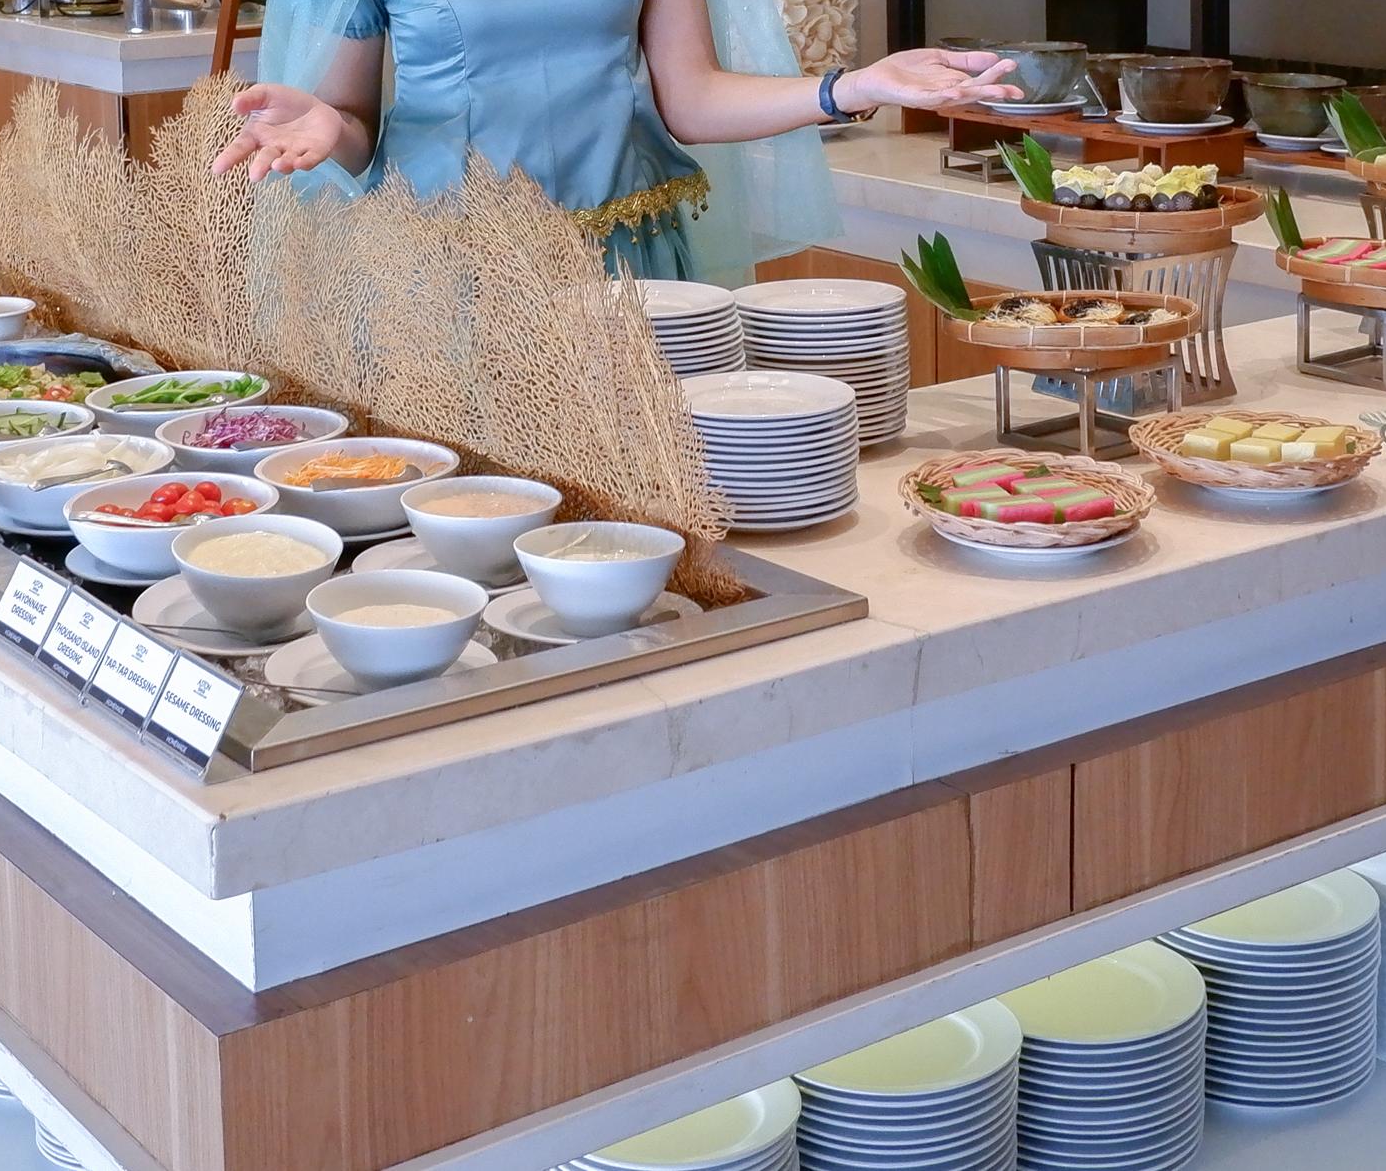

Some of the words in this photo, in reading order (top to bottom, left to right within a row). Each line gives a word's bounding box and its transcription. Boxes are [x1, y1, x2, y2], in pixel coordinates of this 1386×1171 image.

[11, 604, 37, 625] DRESSING
[13, 589, 48, 615] MAYONNAISE
[54, 622, 82, 646] THOUSAND
[81, 638, 101, 659] ISLAND
[57, 642, 84, 665] DRESSING
[104, 655, 128, 677] TAR-TAR
[127, 670, 157, 696] DRESSING
[164, 690, 191, 713] SESAME
[188, 705, 222, 733] DRESSING
